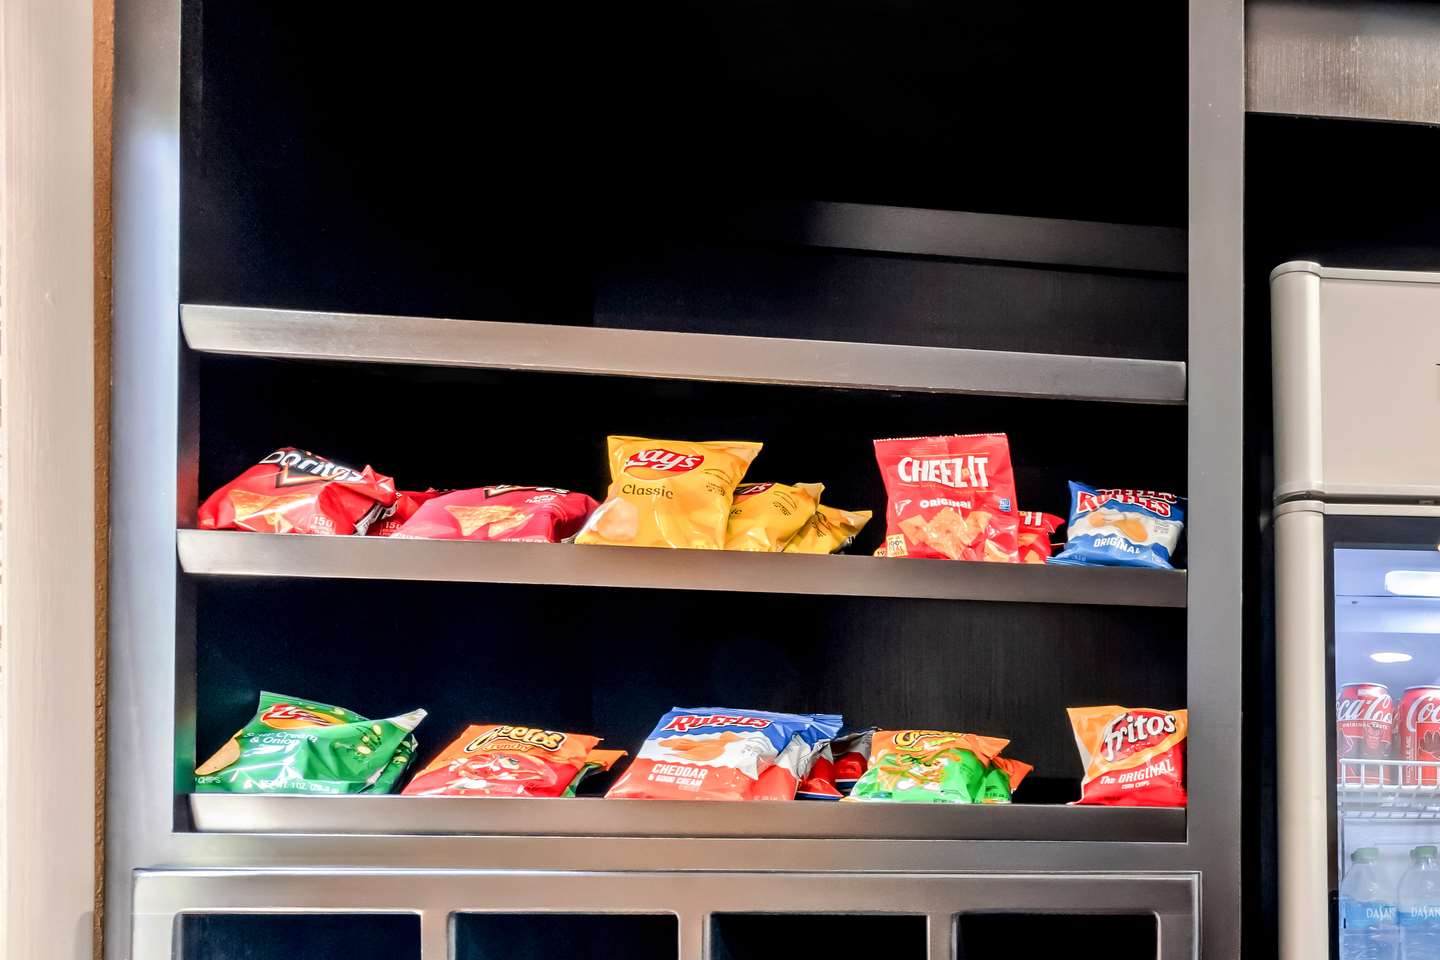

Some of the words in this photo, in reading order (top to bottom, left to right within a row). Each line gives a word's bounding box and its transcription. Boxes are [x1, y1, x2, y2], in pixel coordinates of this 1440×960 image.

[622, 484, 674, 499] Classic
[1094, 537, 1140, 554] ORIGINAL
[661, 715, 774, 732] RUFFLES
[652, 764, 708, 778] CHEDDAR
[1118, 759, 1174, 783] ORIGINAL
